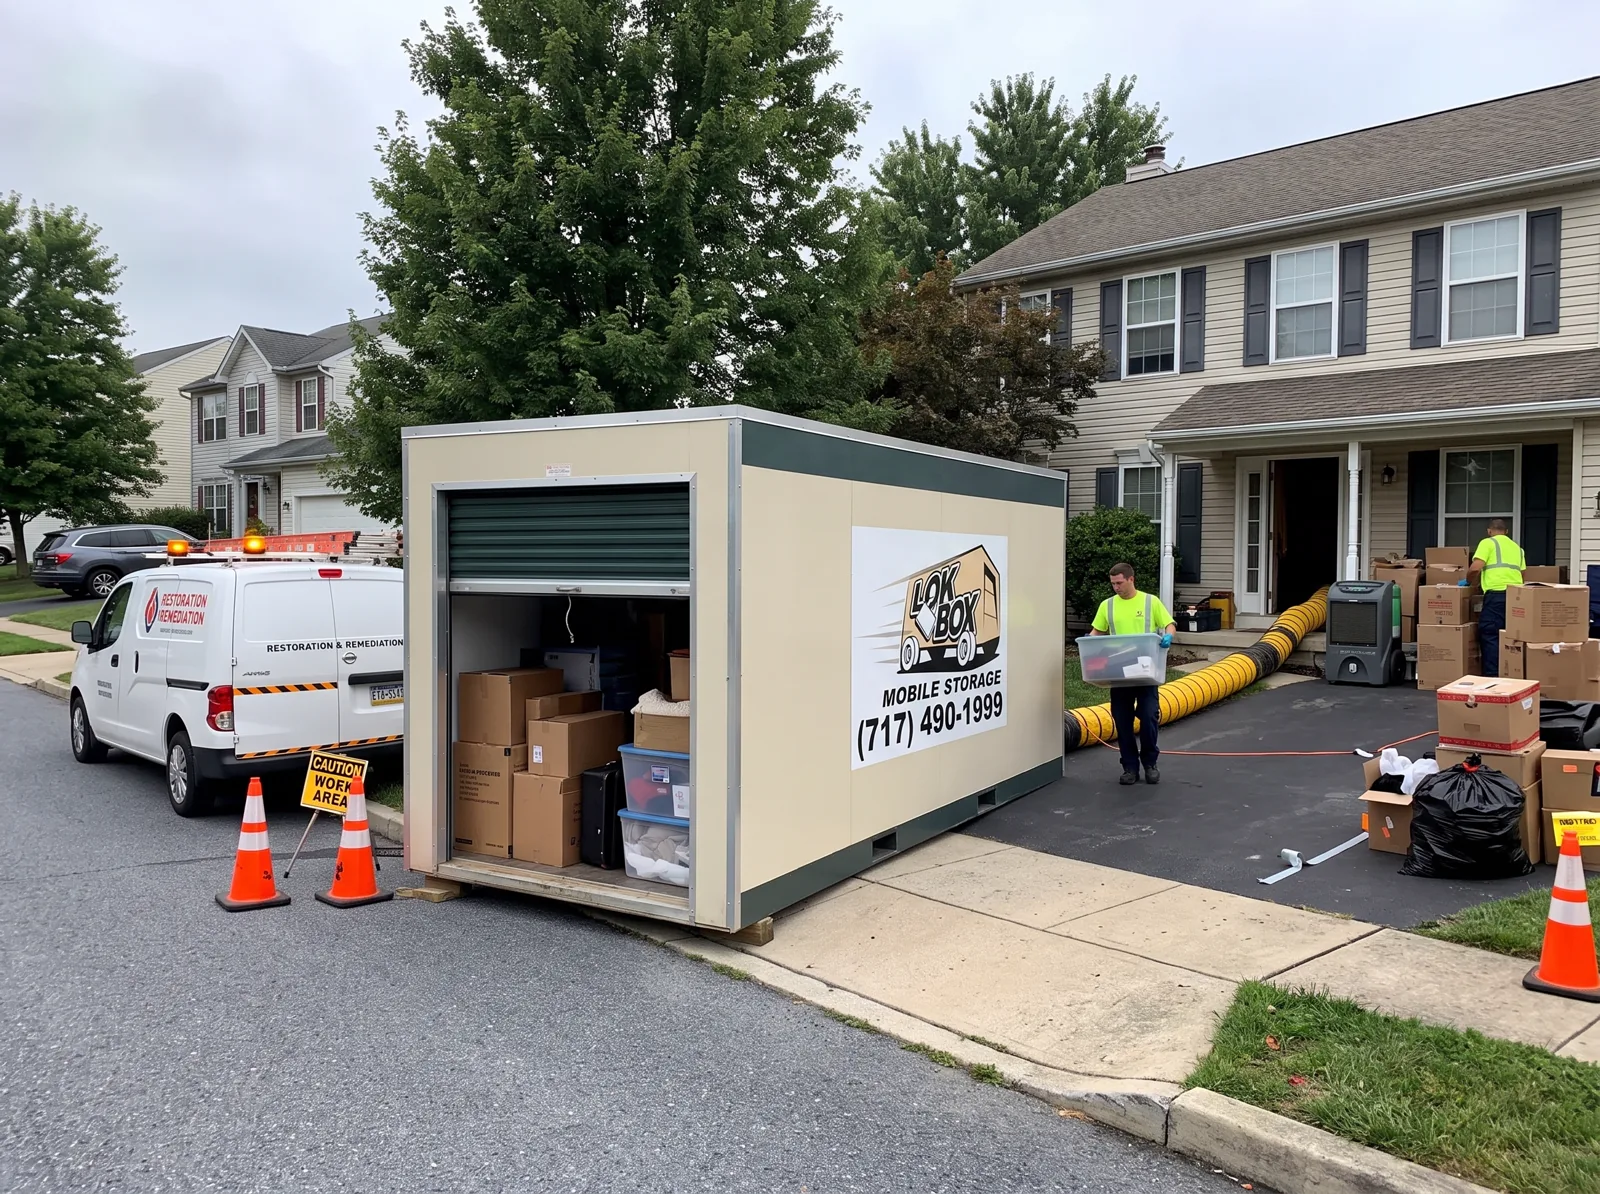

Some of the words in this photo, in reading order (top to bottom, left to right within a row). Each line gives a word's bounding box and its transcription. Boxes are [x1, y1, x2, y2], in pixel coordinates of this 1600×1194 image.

[161, 593, 208, 608] RESTORATION
[910, 561, 960, 618] LOK
[933, 589, 981, 642] BOX
[267, 642, 333, 653] RESTORATION
[336, 641, 342, 649] &
[345, 639, 404, 649] REMEDIATION
[882, 680, 941, 708] MOBILE
[943, 669, 1002, 695] STORAGE
[857, 710, 914, 762] (717)
[920, 691, 1003, 736] 490-1999
[313, 756, 363, 777] CAUTION
[312, 789, 348, 808] AREA
